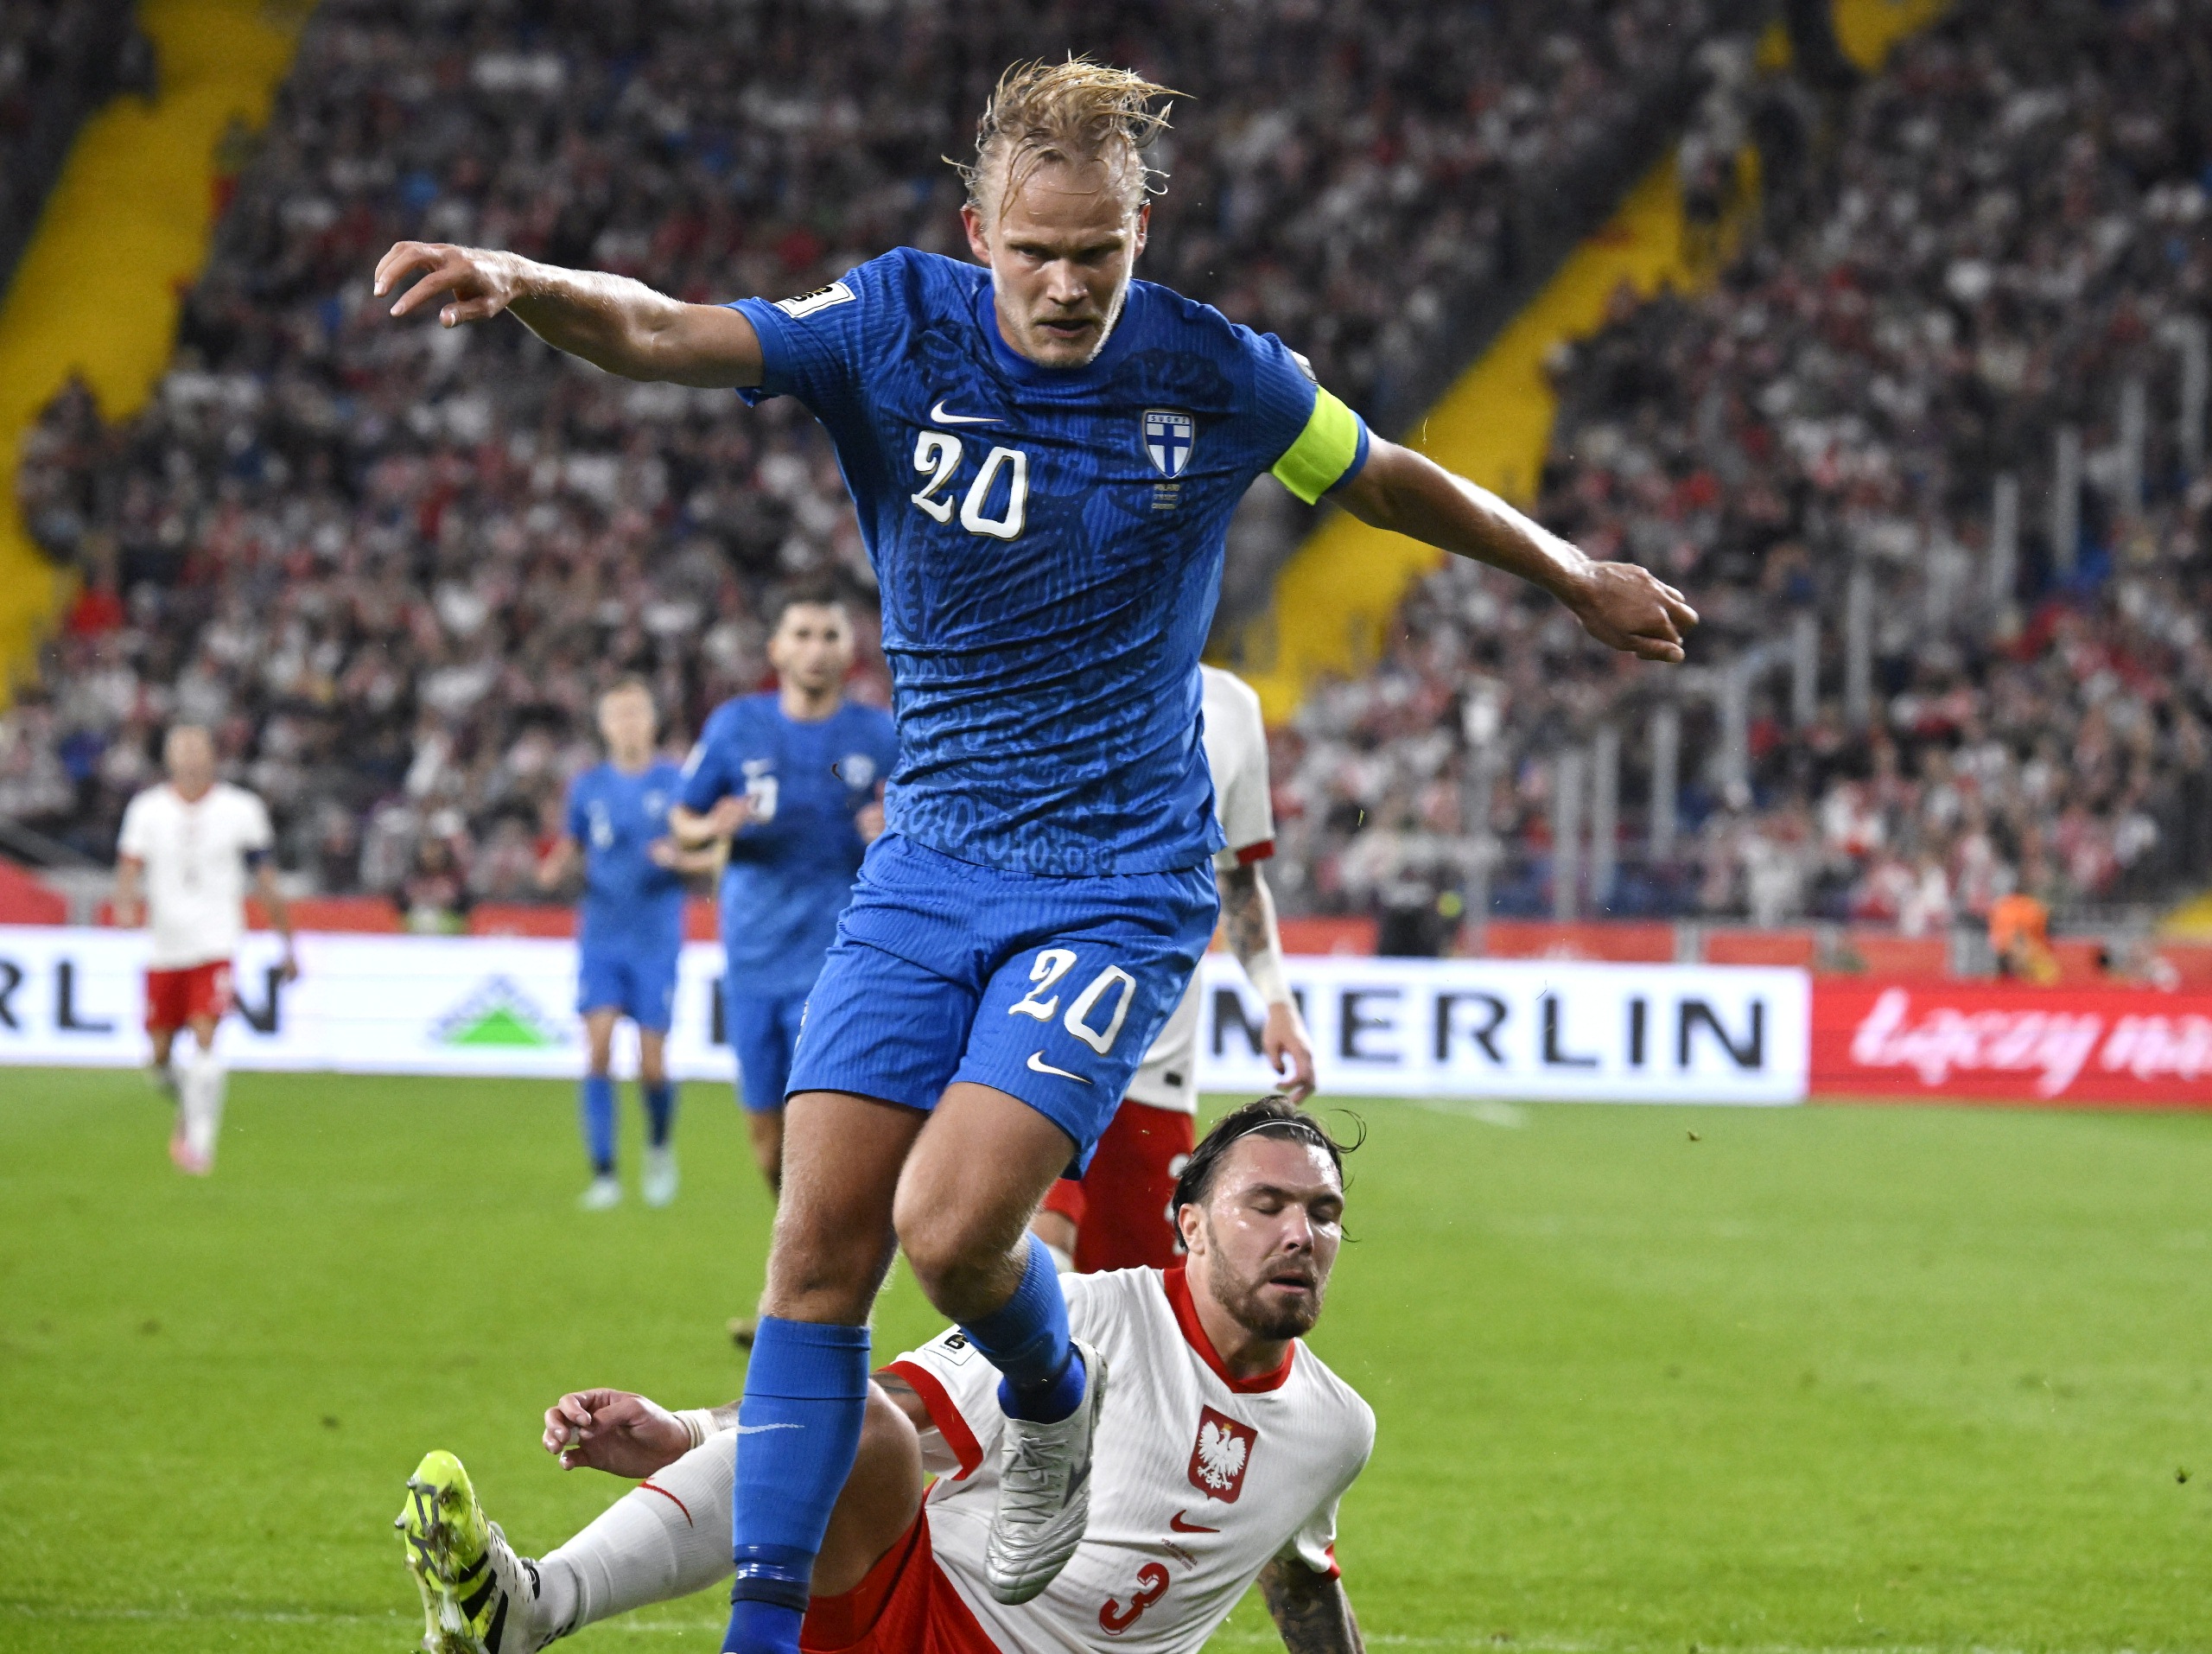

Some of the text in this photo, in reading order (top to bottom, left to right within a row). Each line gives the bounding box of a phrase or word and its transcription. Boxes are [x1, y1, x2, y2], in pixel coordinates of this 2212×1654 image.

[911, 429, 1029, 542] 20
[1007, 949, 1138, 1057] 20
[1098, 1562, 1170, 1636] 3
